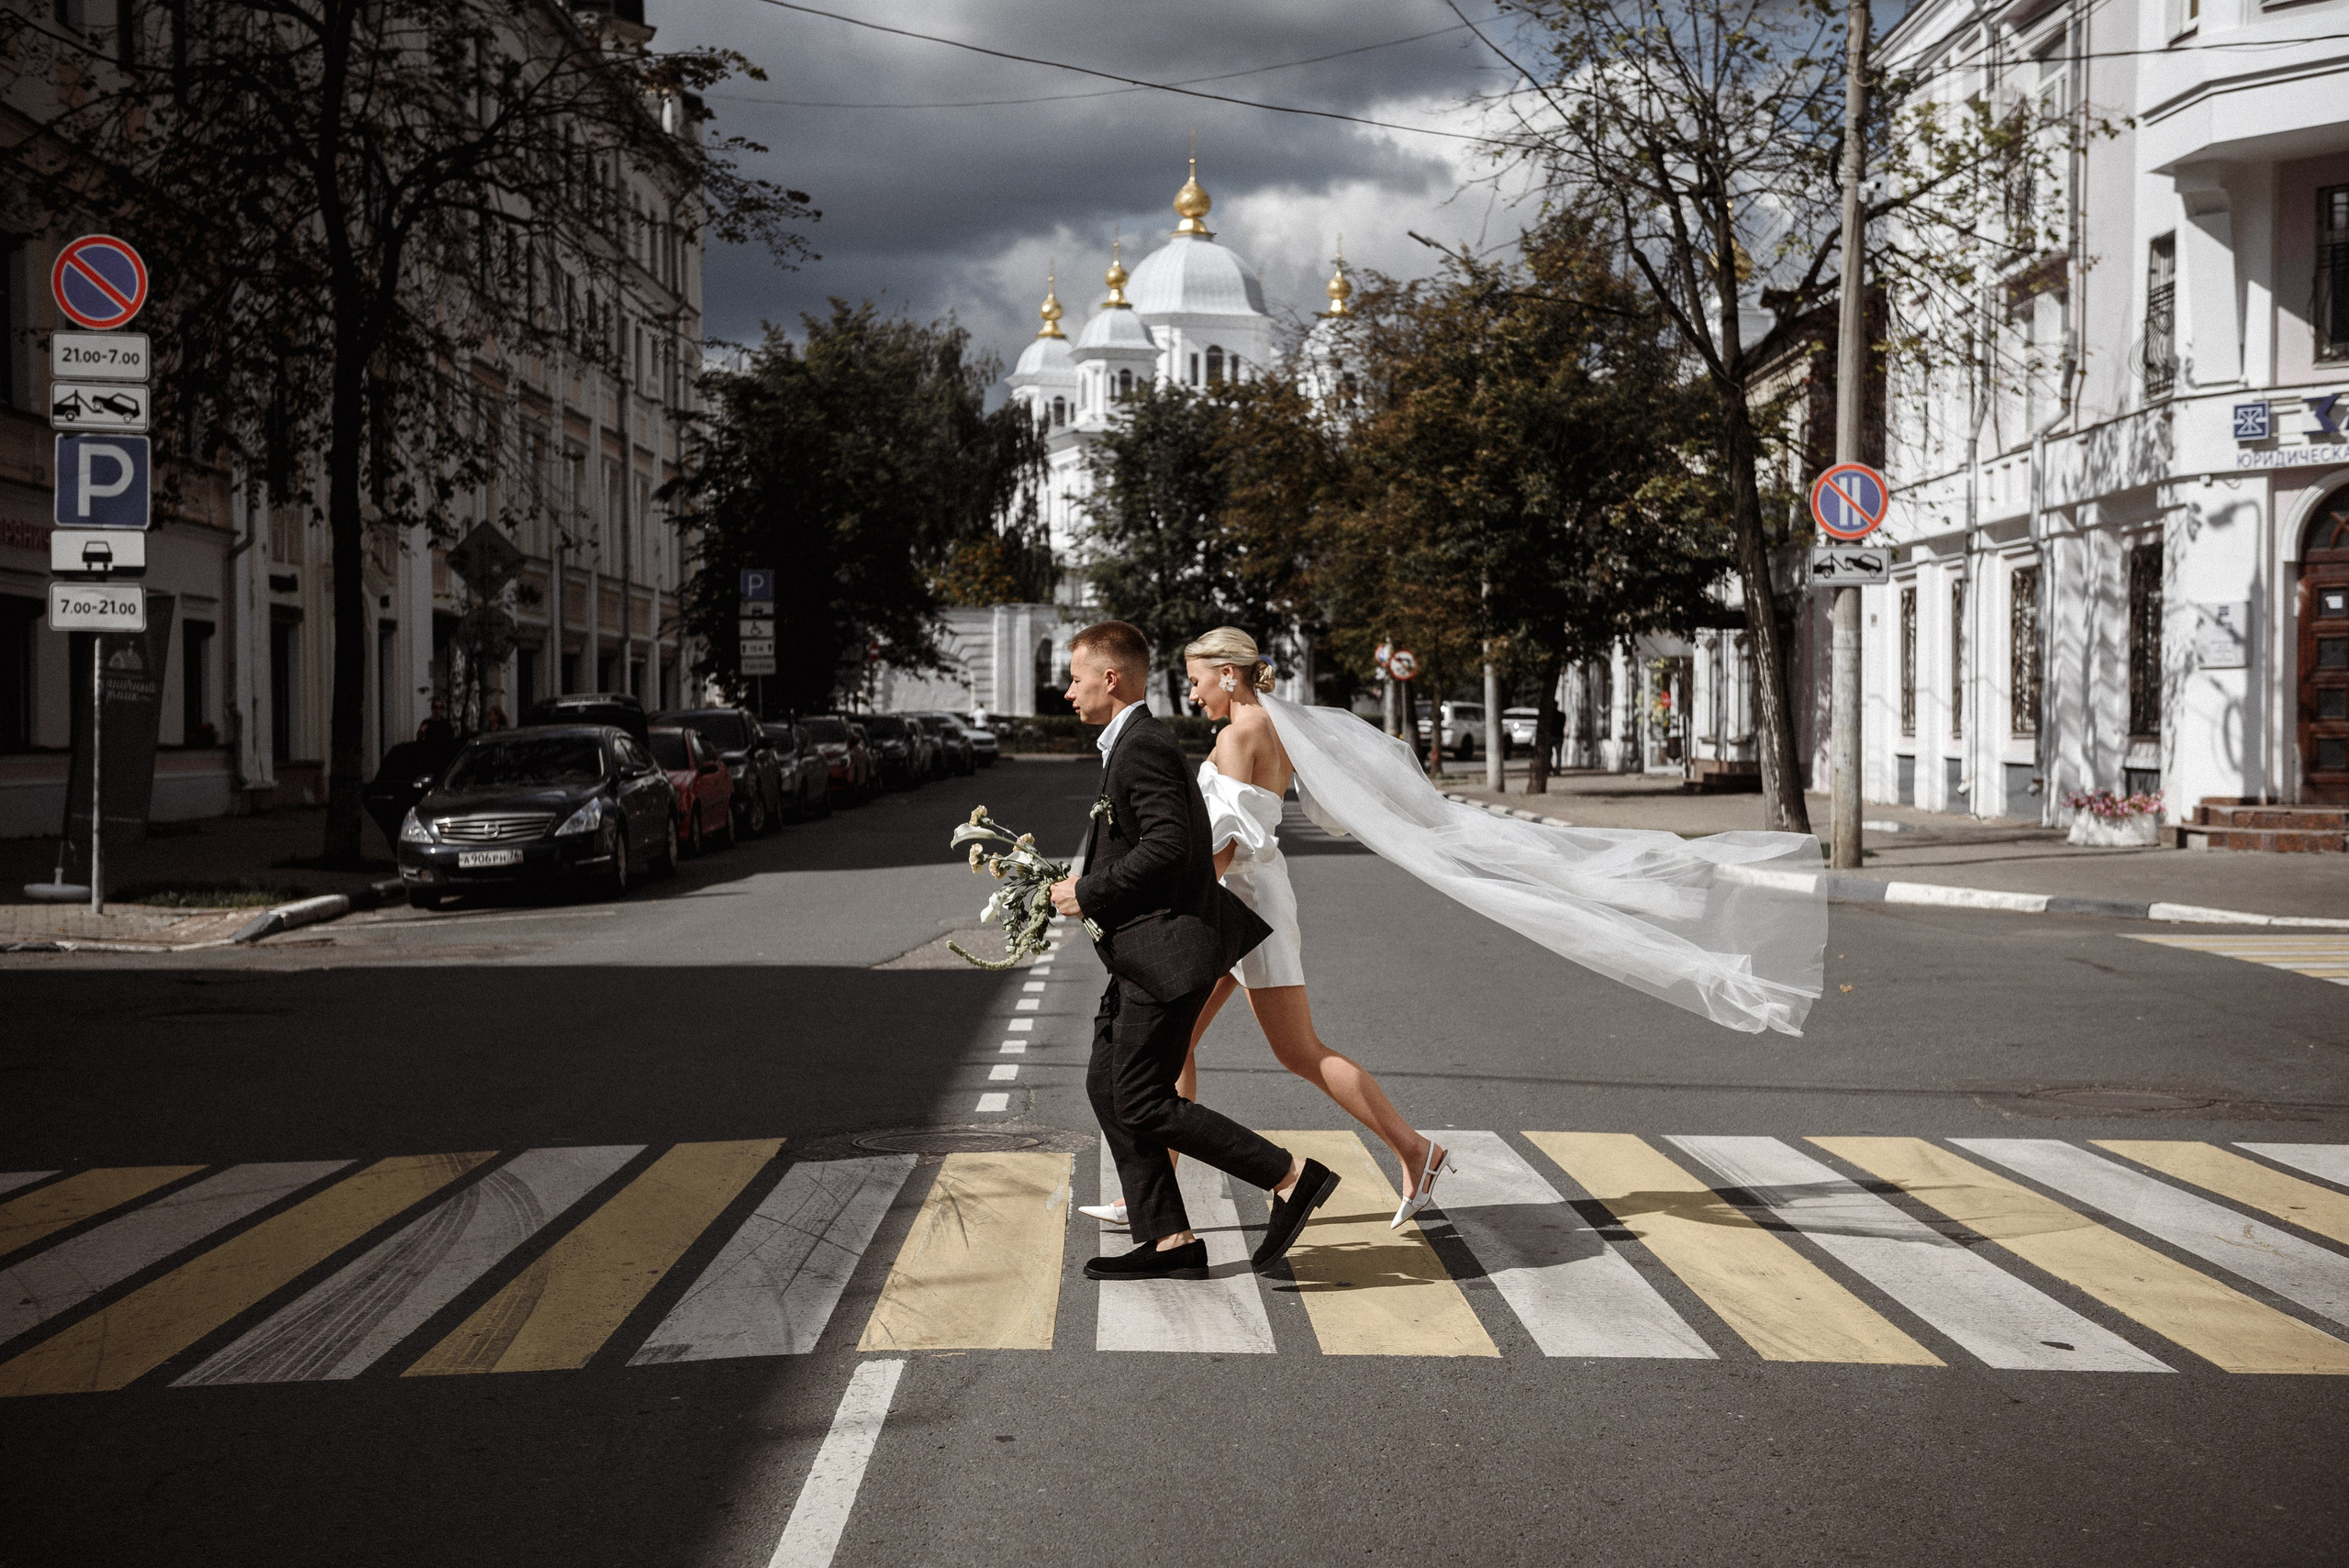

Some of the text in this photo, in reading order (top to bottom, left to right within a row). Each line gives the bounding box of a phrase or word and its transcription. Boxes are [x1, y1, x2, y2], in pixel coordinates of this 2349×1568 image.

[61, 347, 139, 365] 21.00-7.00
[78, 443, 134, 517] P
[748, 574, 763, 596] P
[61, 599, 137, 616] 7.00-21.00
